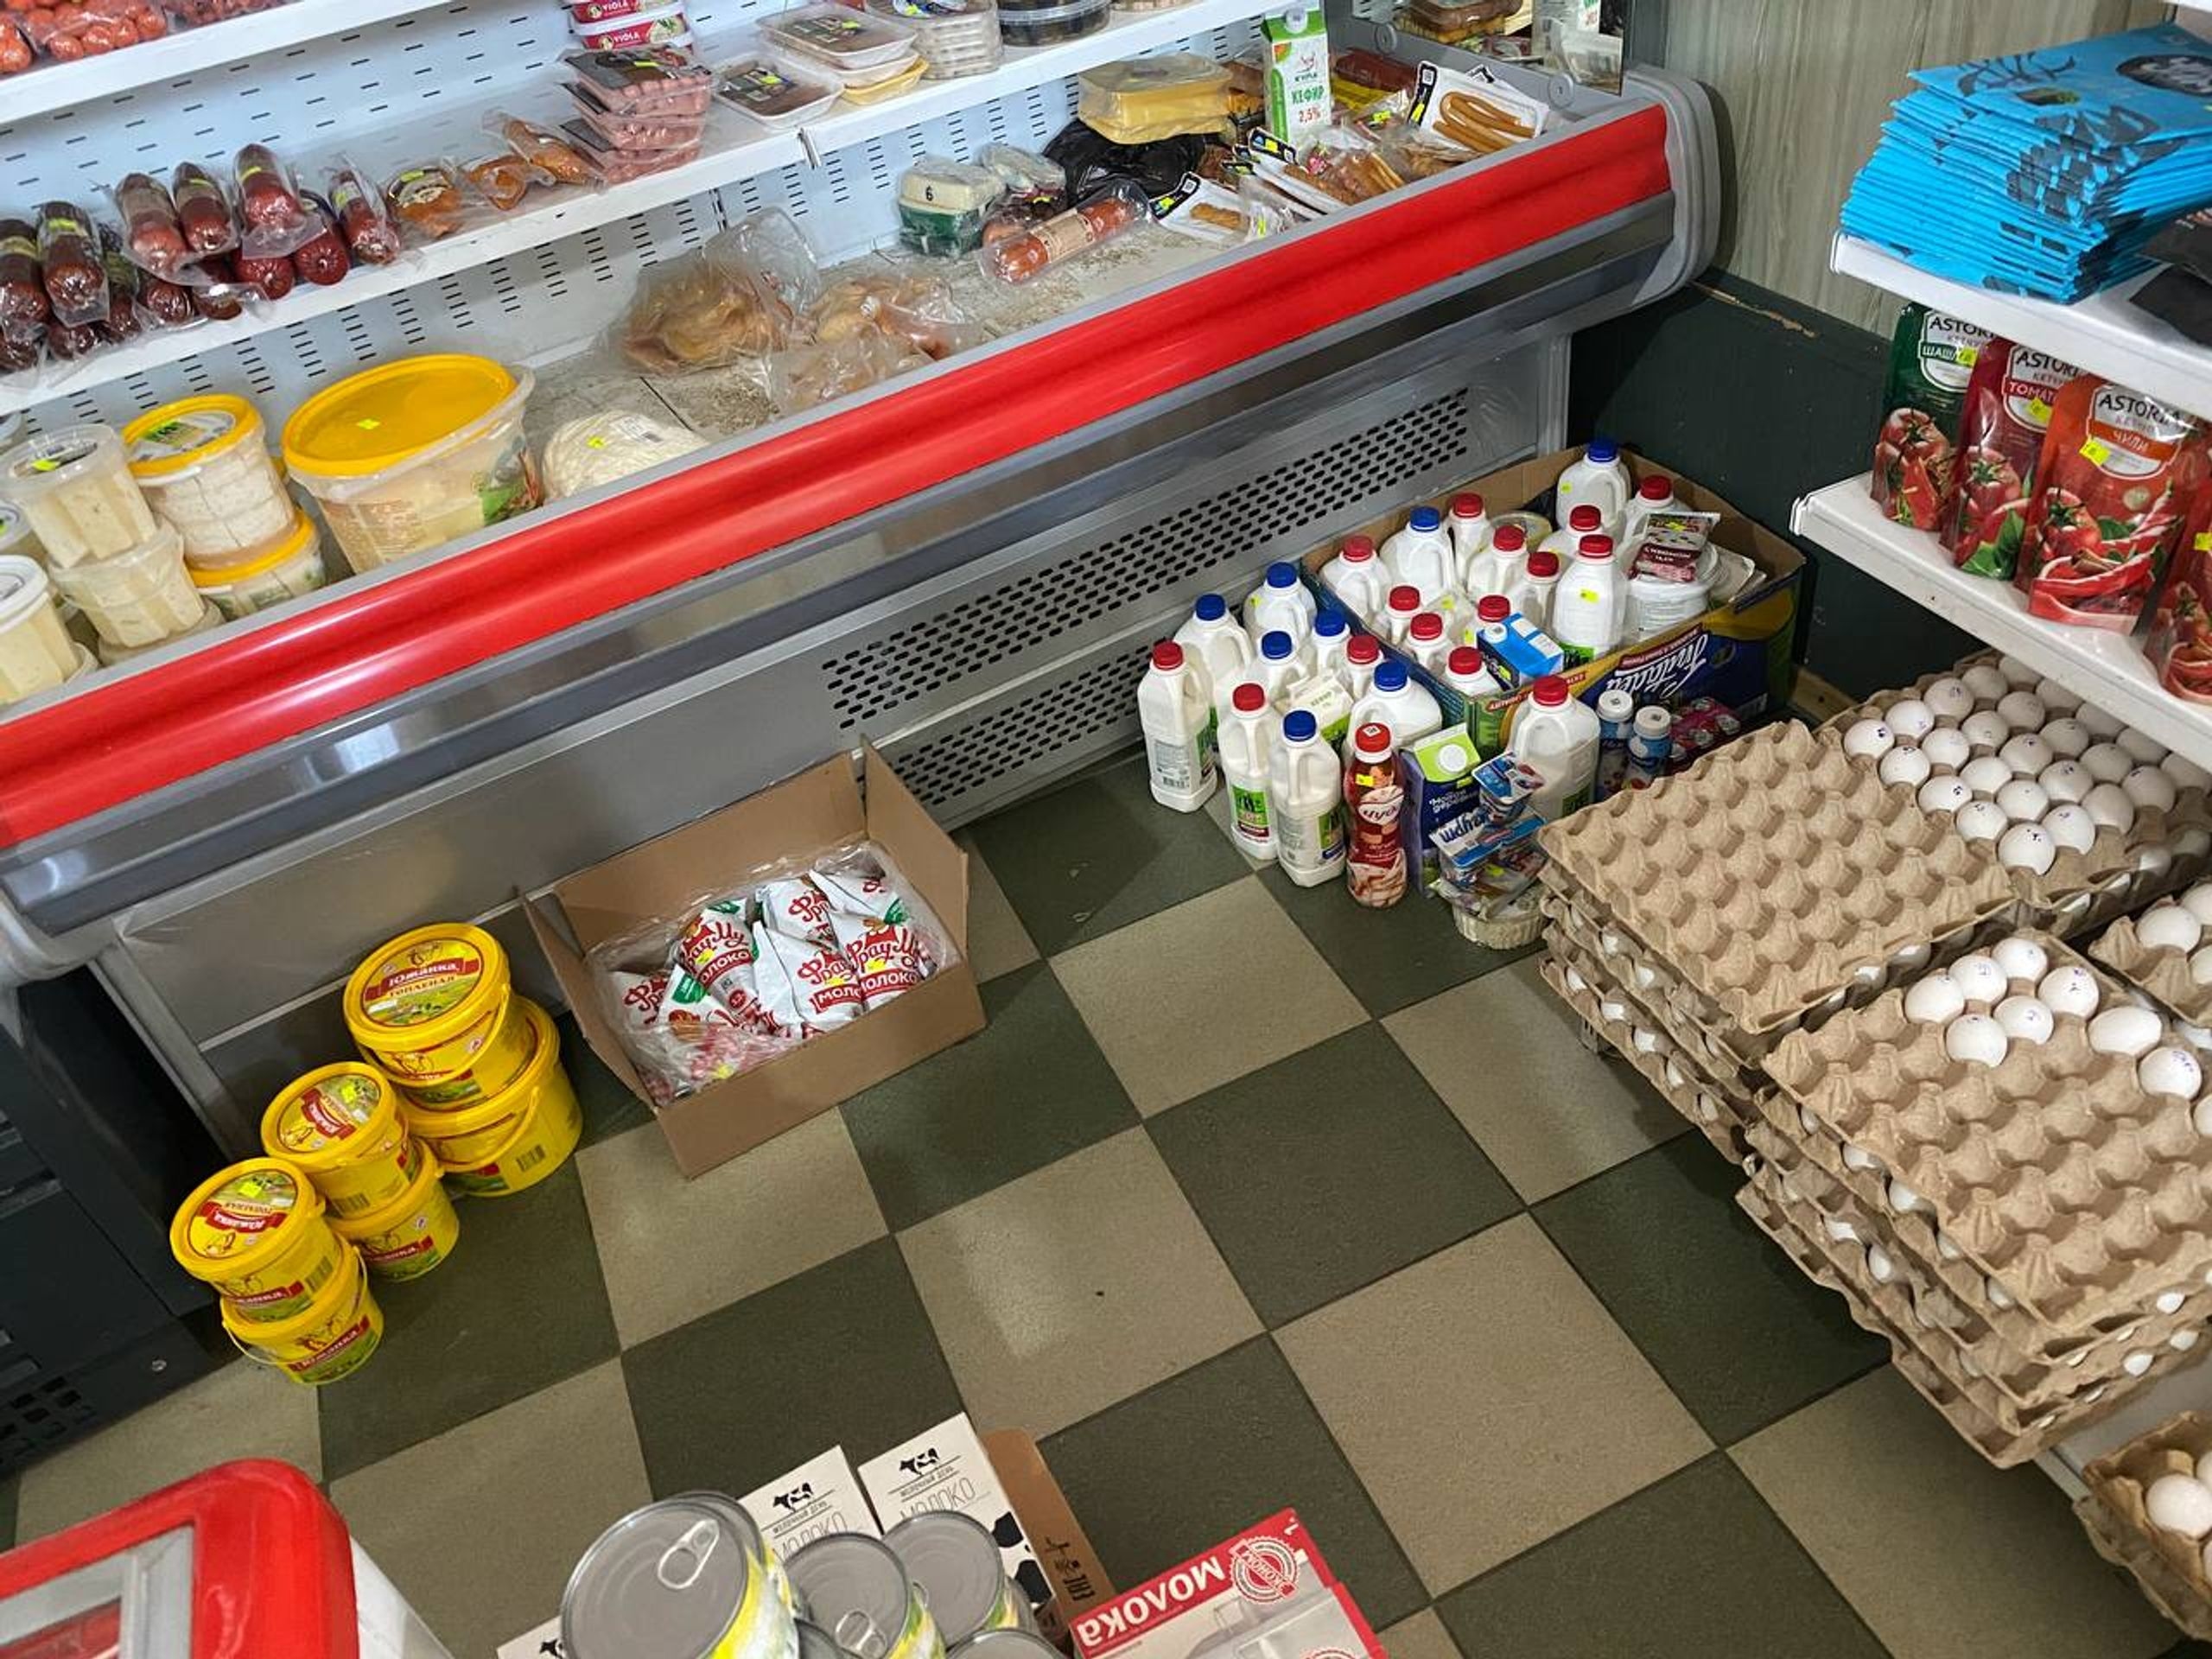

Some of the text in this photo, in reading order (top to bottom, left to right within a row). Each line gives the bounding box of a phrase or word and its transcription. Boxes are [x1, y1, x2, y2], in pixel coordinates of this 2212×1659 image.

[602, 1, 628, 12] VIOLA
[613, 31, 639, 42] VIOLA
[1292, 86, 1324, 104] КЕФИР
